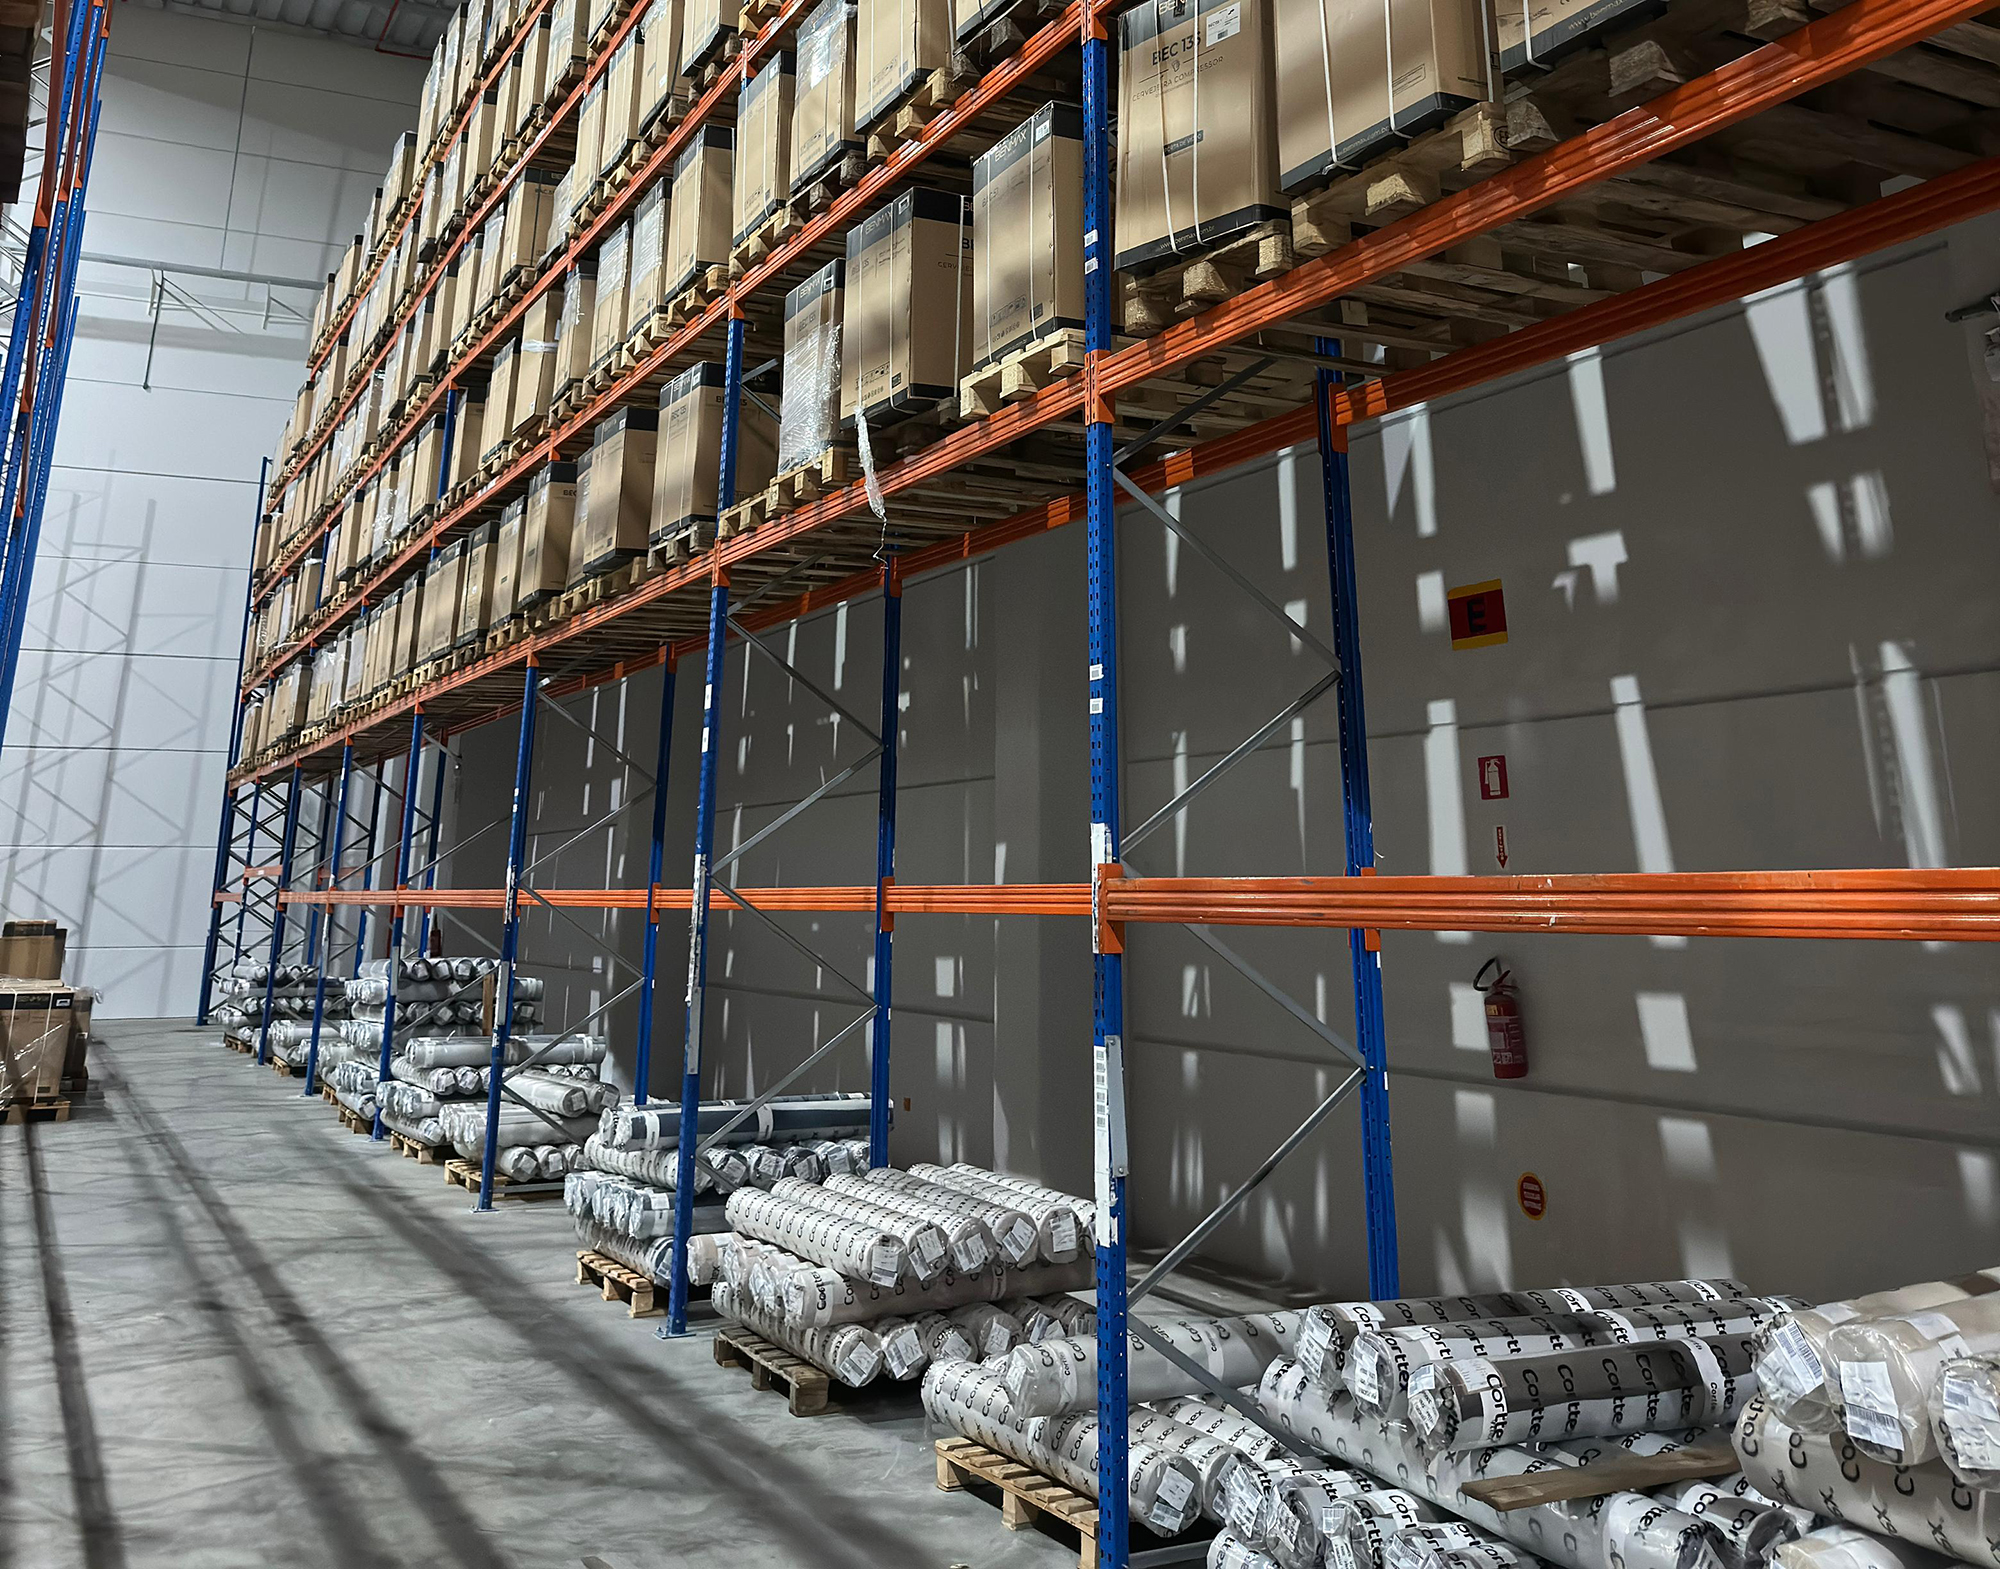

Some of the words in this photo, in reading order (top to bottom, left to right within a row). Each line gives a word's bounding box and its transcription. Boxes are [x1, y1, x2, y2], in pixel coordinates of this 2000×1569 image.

[1152, 42, 1178, 65] BEC
[1174, 56, 1224, 83] COMPESSOR
[1467, 598, 1487, 633] E
